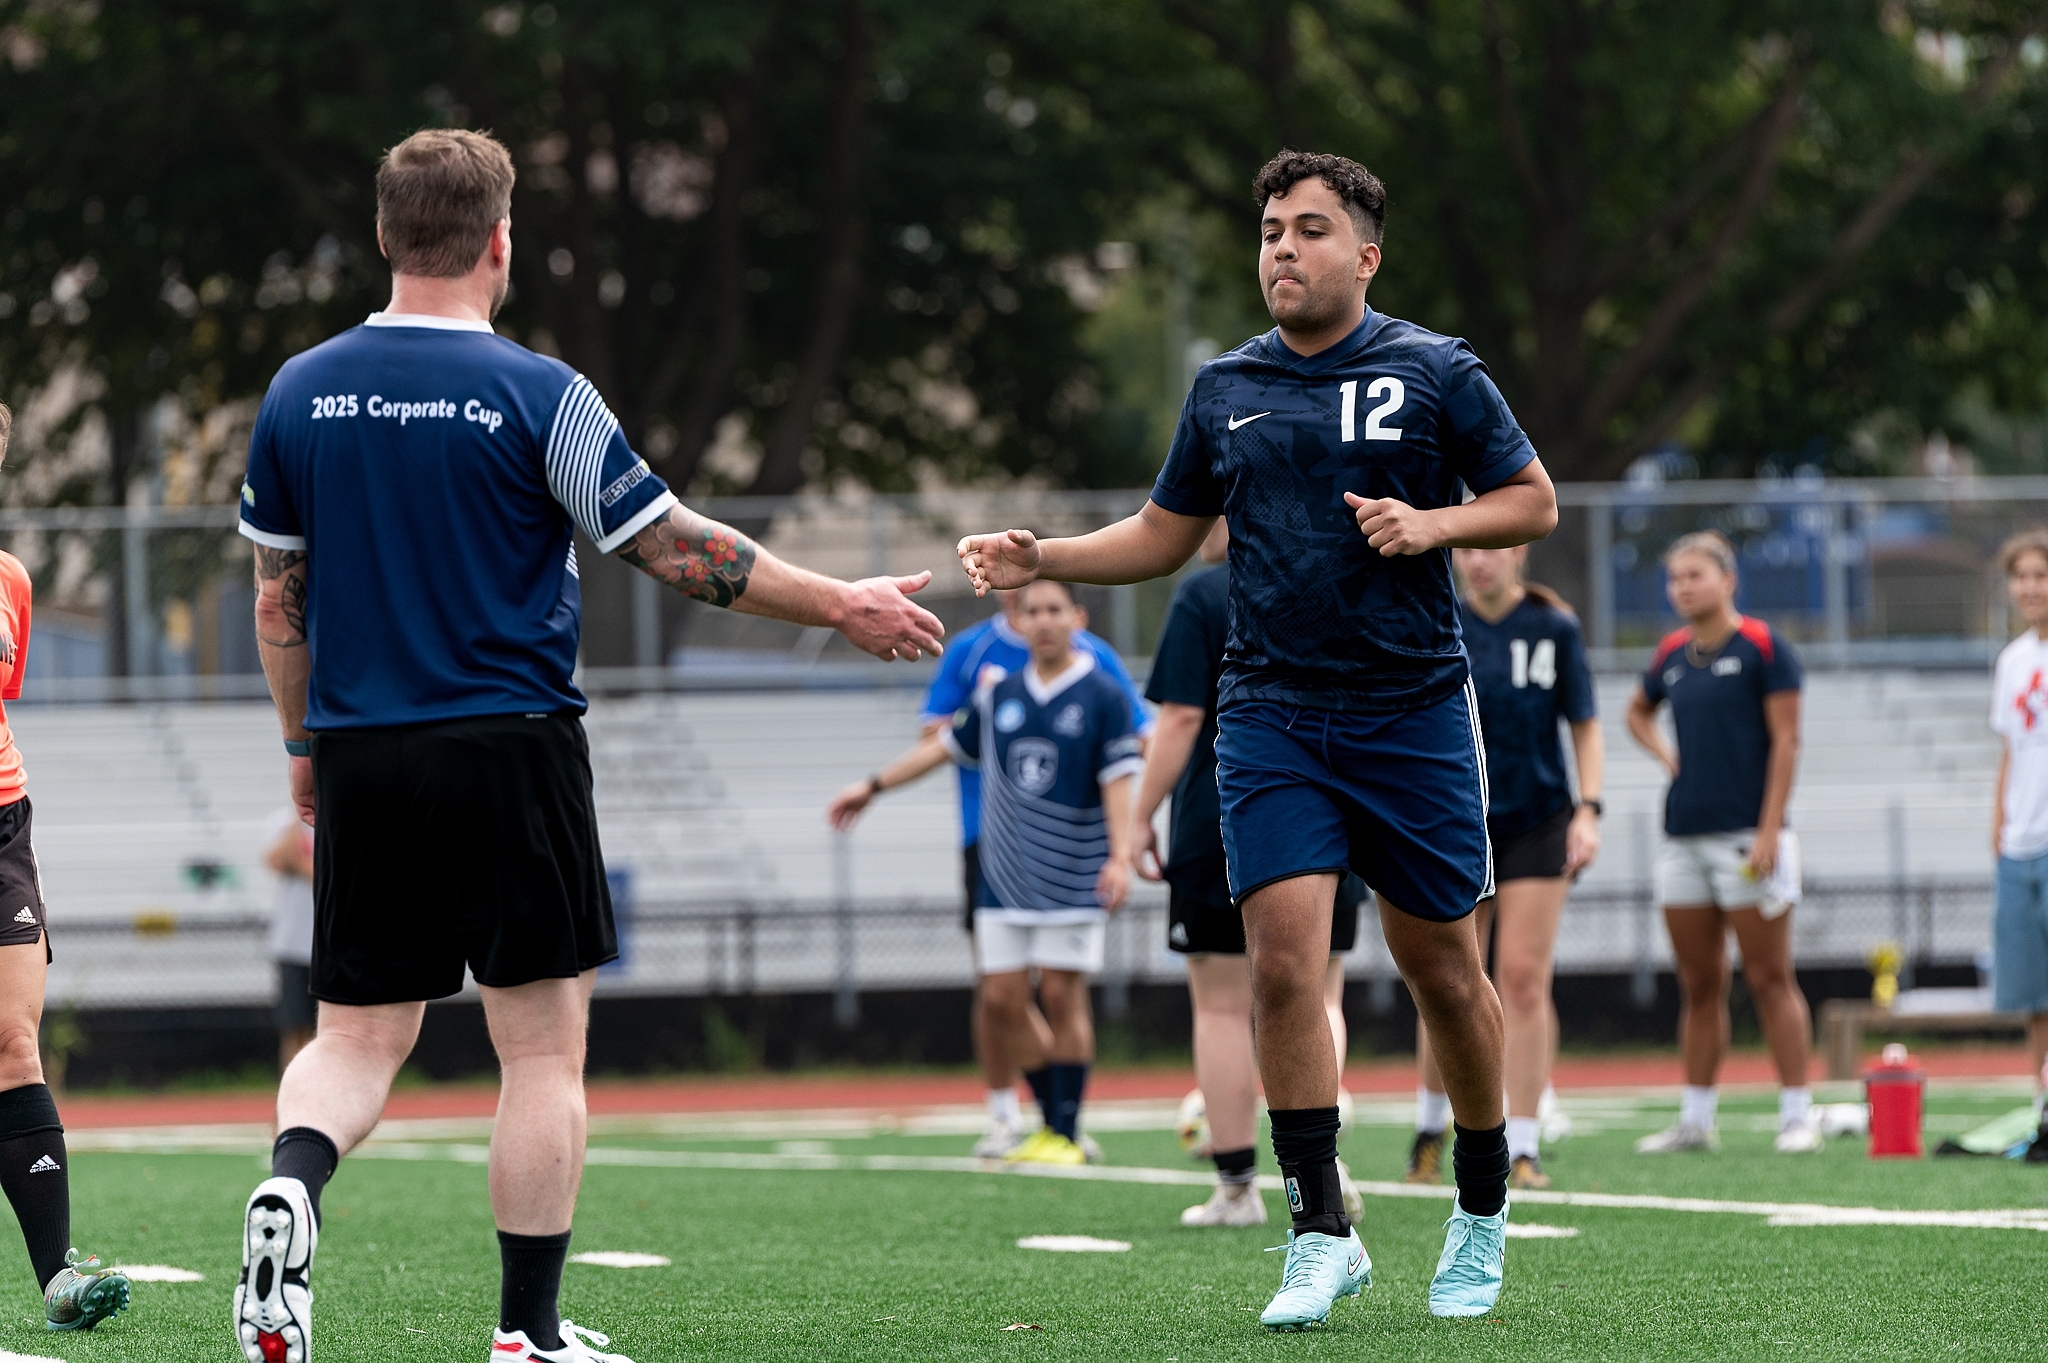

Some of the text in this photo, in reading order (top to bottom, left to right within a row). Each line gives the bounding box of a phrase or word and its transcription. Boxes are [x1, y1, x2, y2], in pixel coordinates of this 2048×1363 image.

[311, 394, 504, 434] 2025 Corporate Cup
[1339, 376, 1405, 443] 12
[600, 478, 629, 506] BEST
[1510, 638, 1557, 691] 14
[13, 915, 37, 924] adidas
[29, 1164, 61, 1174] adidas
